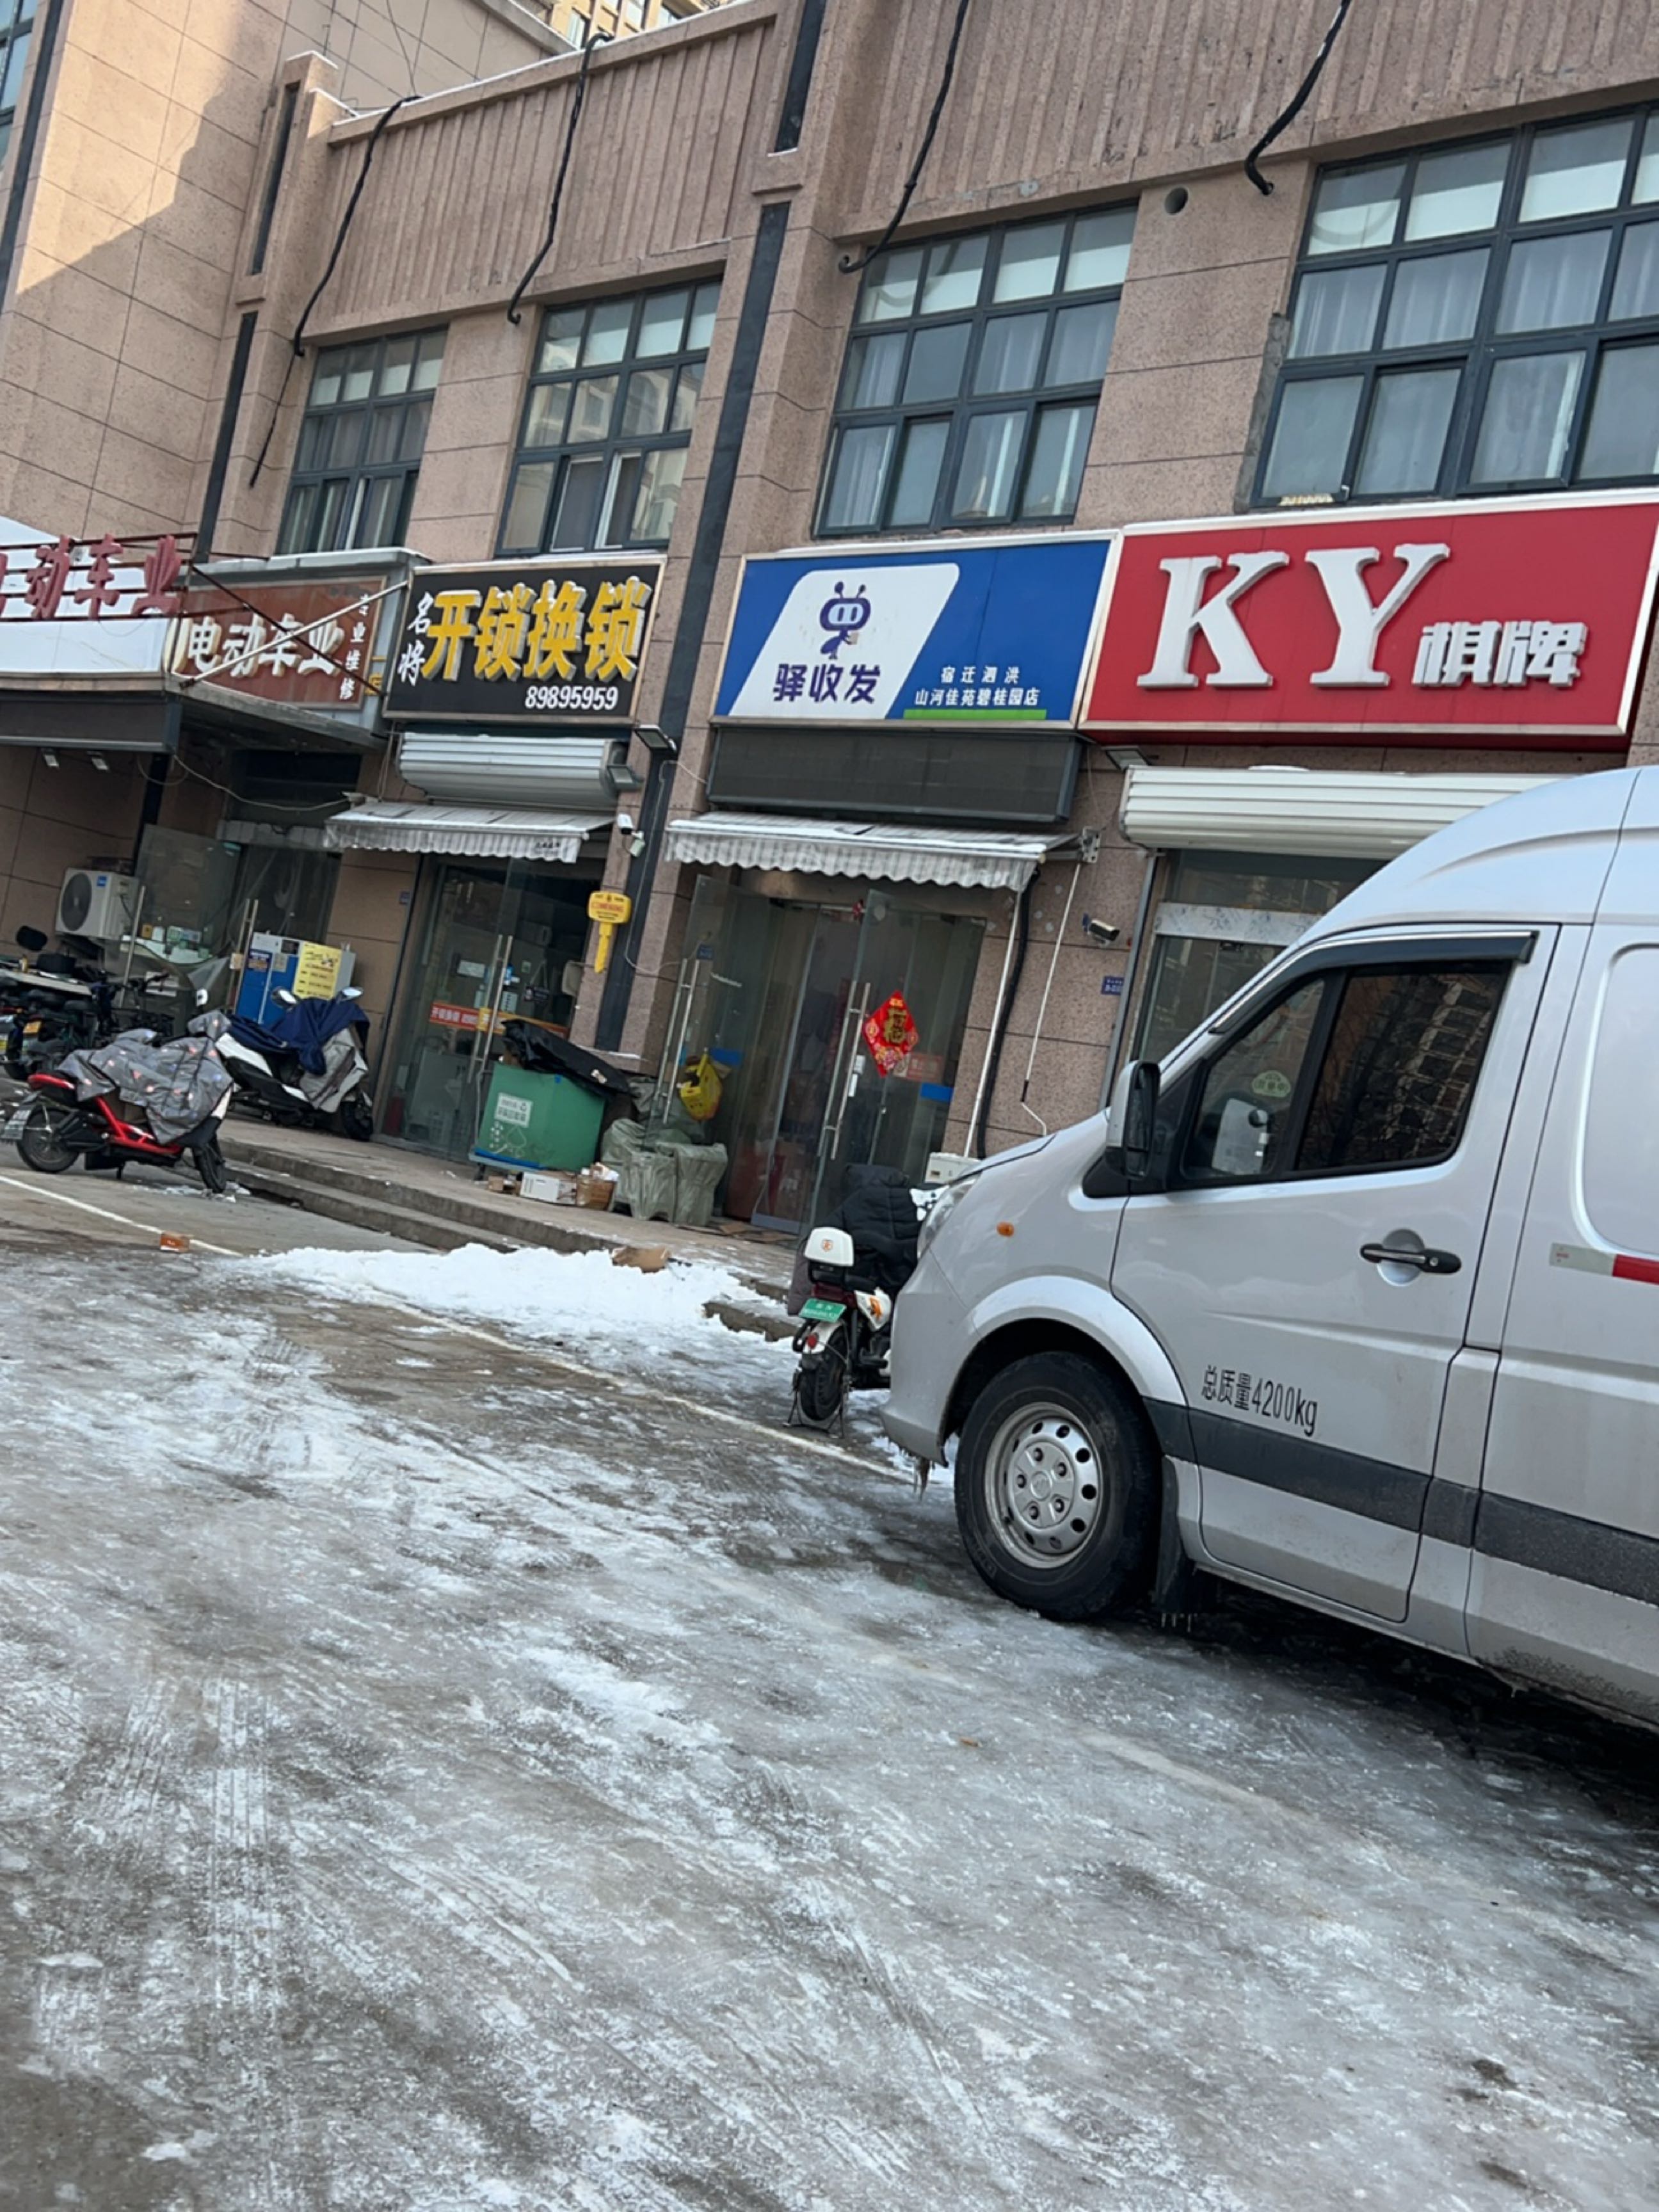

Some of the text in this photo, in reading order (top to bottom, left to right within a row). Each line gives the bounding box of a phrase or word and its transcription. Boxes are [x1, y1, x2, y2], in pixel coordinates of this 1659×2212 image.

[188, 613, 346, 678] 电动车业
[397, 591, 434, 686] 名将
[421, 575, 653, 682] 开锁换锁
[1136, 543, 1588, 688] KY 棋牌
[525, 686, 619, 710] 89895959
[773, 663, 881, 703] 驿收发
[915, 687, 1041, 706] 山河佳苑碧桂园店
[941, 665, 1020, 684] 宿迁泗洪
[1201, 1364, 1318, 1437] 总质量4200kg
